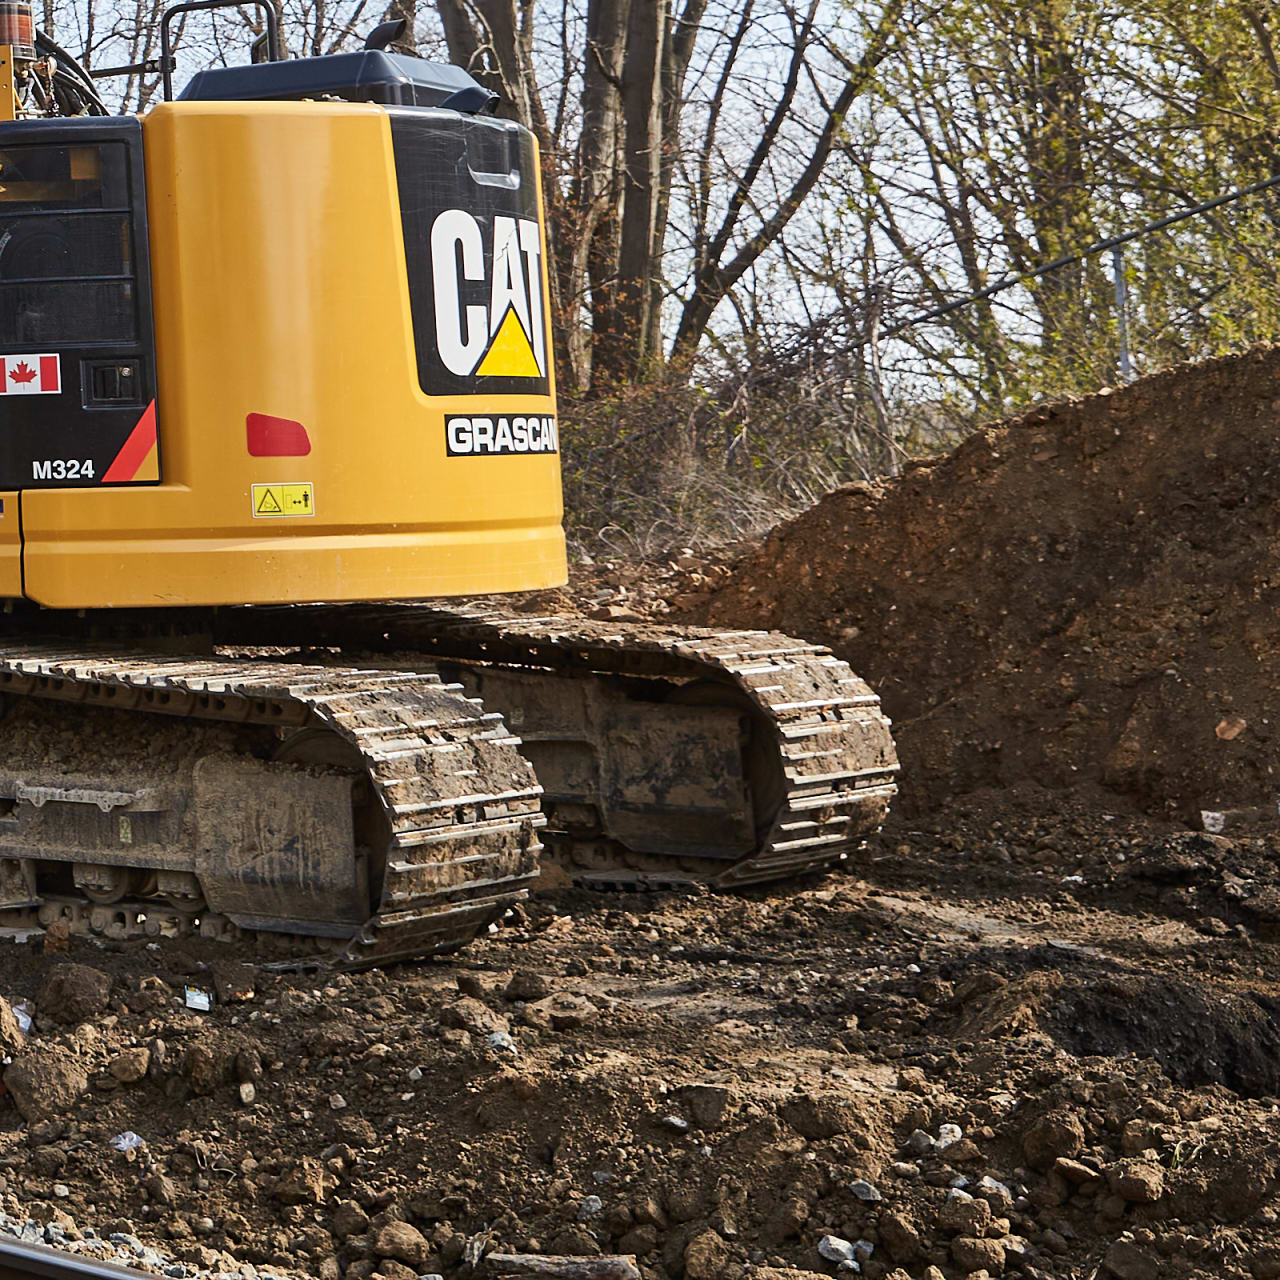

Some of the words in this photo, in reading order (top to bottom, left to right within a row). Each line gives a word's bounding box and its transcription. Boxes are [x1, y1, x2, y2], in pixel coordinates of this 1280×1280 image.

[431, 209, 546, 378] CAT
[447, 417, 558, 453] GRASCAN
[32, 459, 95, 480] M324
